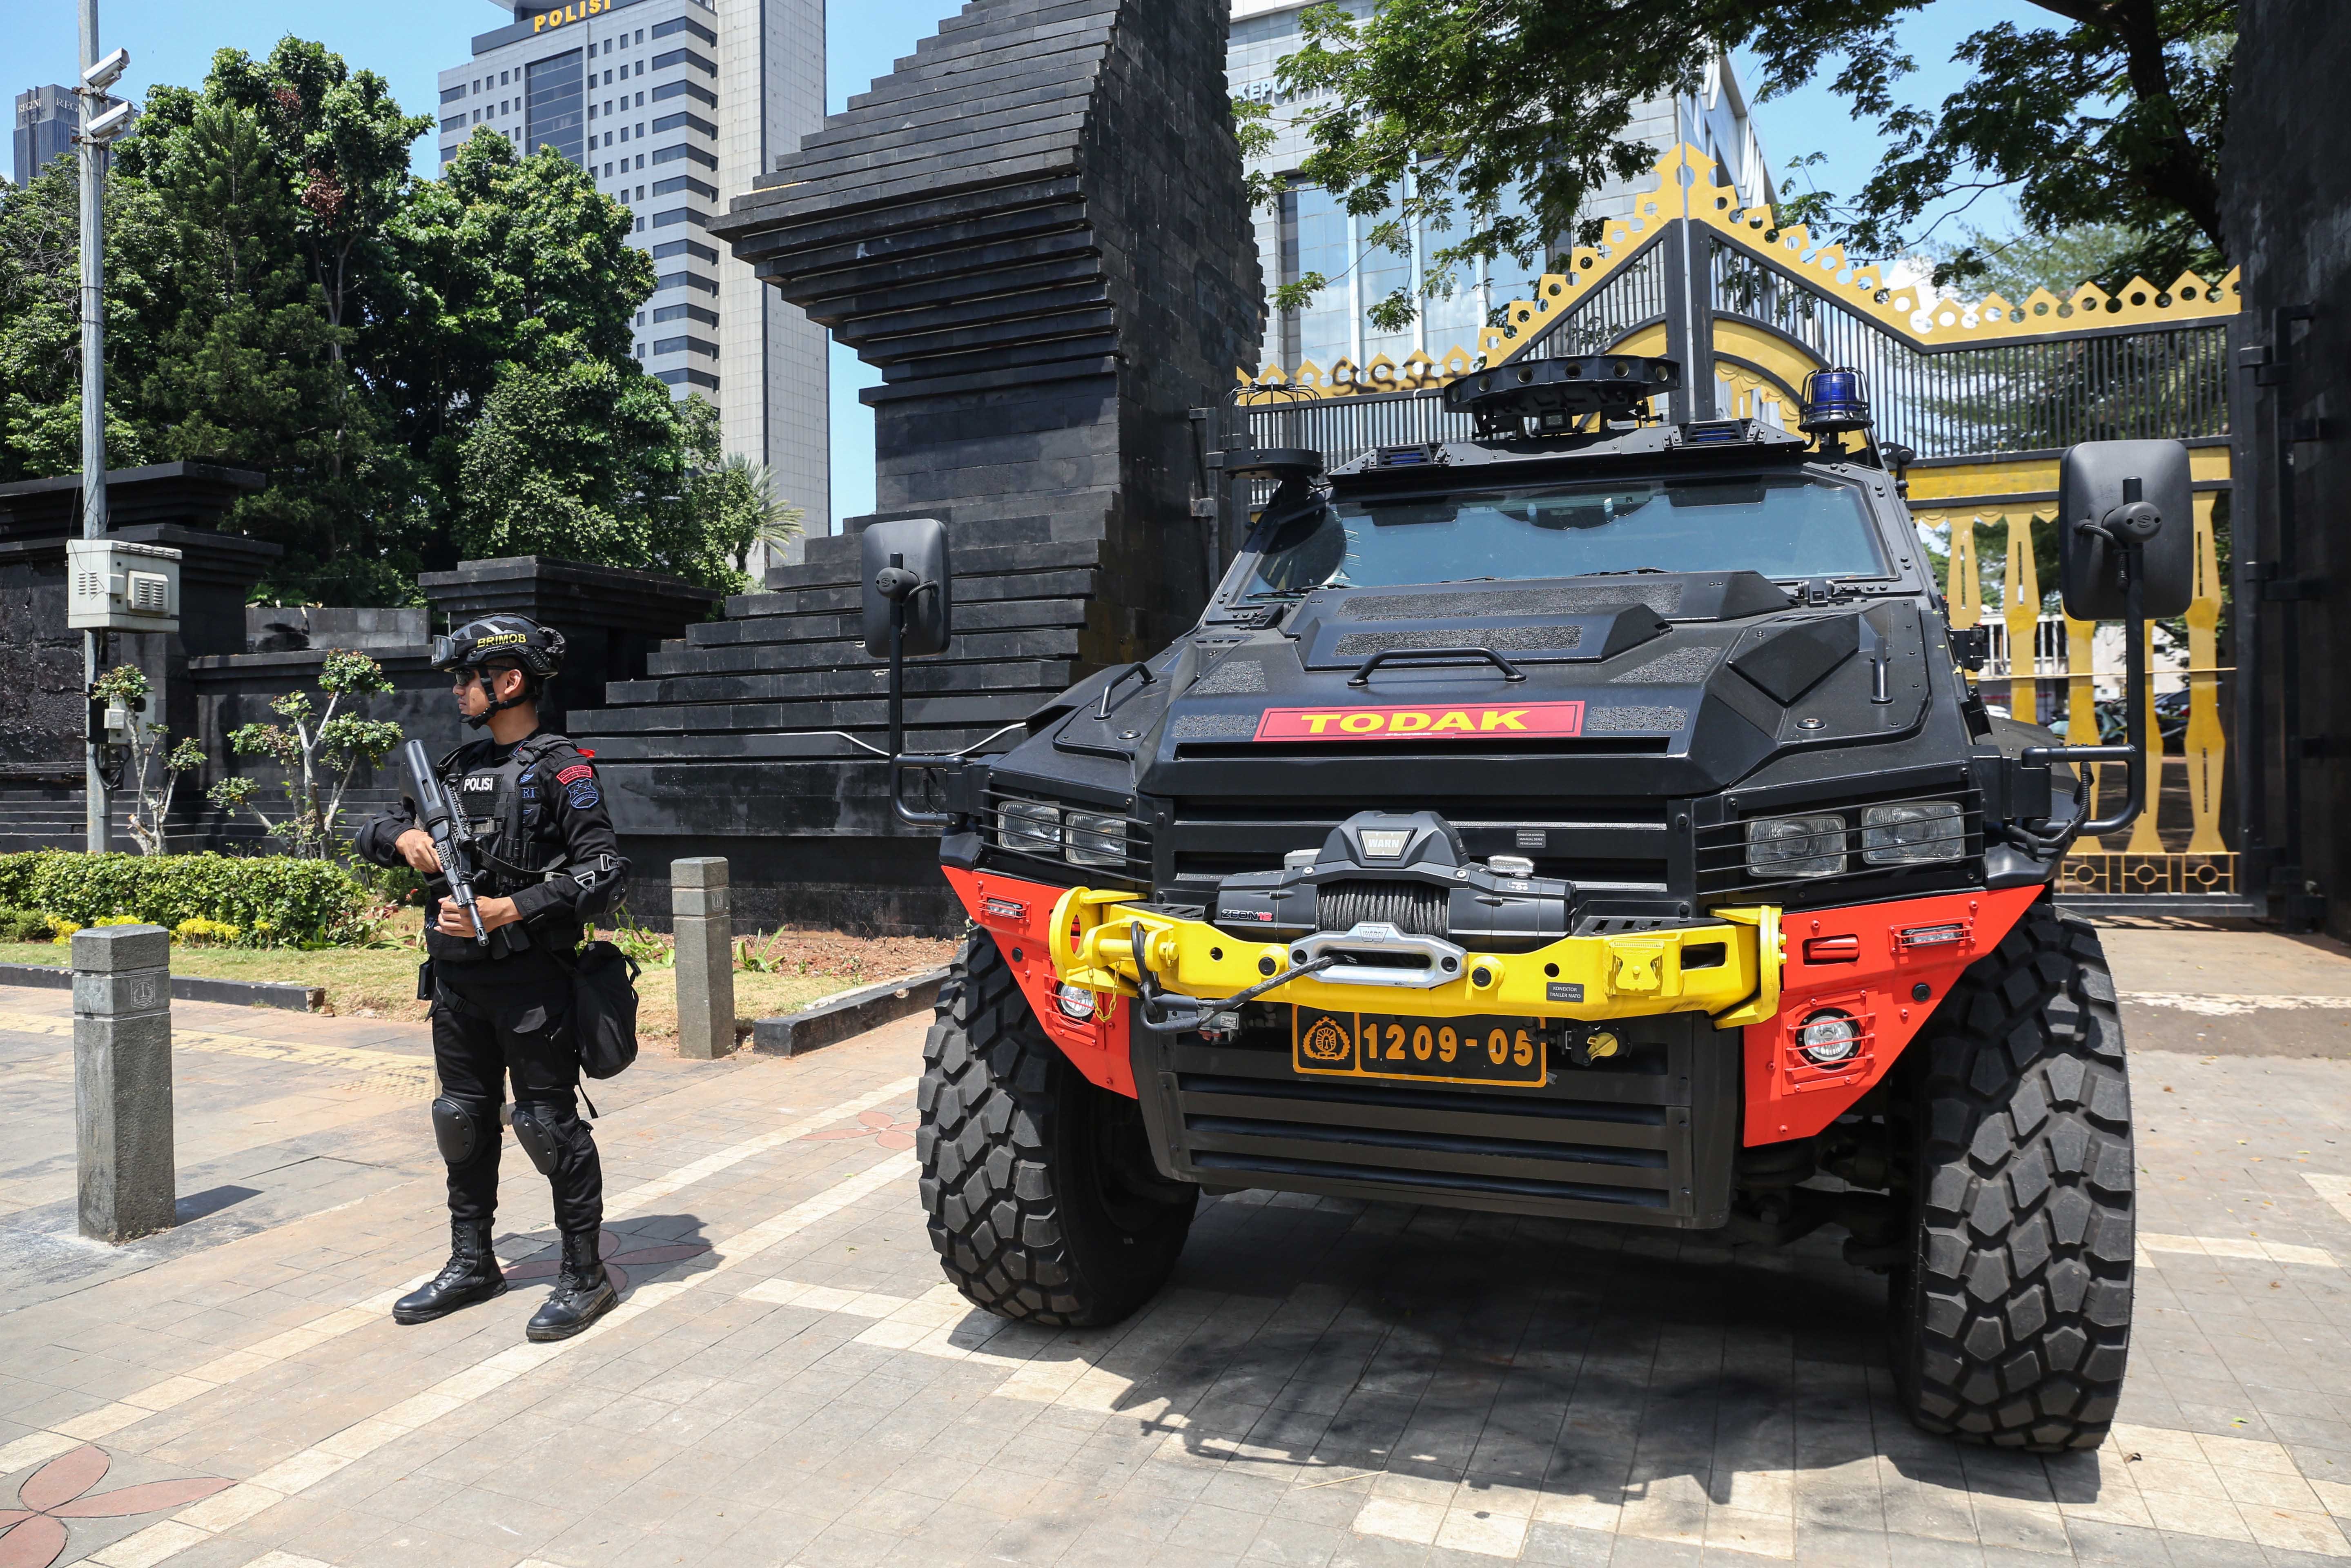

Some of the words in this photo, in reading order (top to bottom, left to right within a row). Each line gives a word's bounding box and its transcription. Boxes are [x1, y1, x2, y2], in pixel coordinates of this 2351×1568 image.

[533, 0, 611, 33] POLISI
[18, 98, 42, 113] REGENT
[56, 98, 78, 112] REG
[477, 633, 526, 648] BRIMOB
[1301, 710, 1531, 733] TODAK
[464, 777, 493, 791] POLISI
[1368, 839, 1399, 848] WARN
